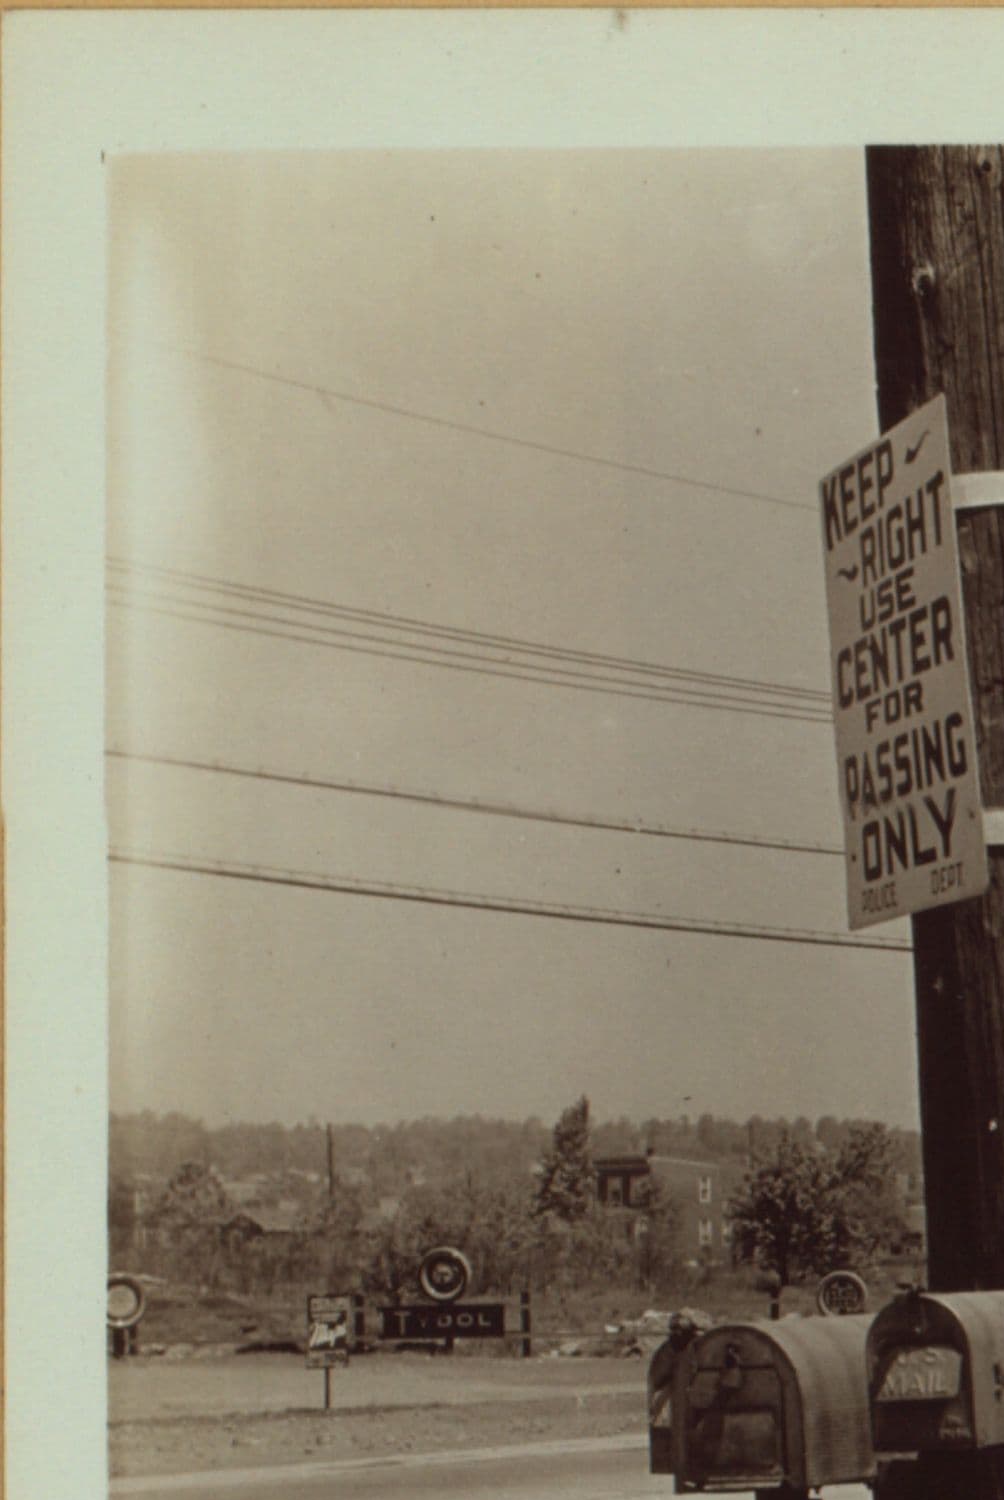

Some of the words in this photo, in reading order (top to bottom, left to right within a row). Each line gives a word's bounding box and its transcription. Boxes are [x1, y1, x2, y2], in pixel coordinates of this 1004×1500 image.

[822, 439, 893, 549] KEEP
[860, 471, 944, 587] RIGHT
[860, 569, 915, 631] USE
[837, 597, 955, 709] CENTER
[866, 682, 924, 733] FOR
[845, 713, 967, 819] PASSING
[862, 788, 957, 882] ONLY
[861, 881, 897, 912] POLICE
[879, 1370, 950, 1397] MAIL
